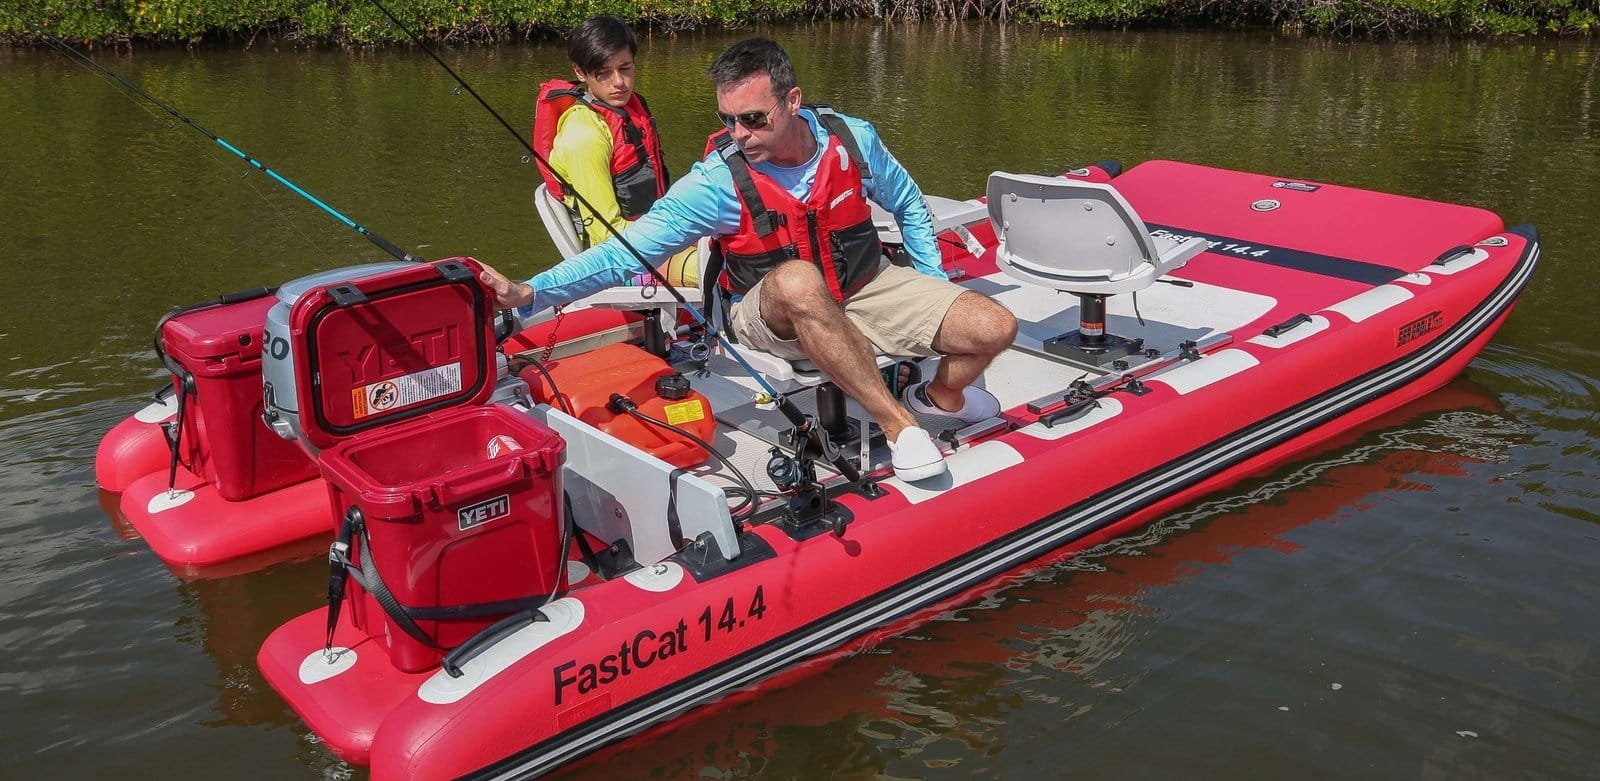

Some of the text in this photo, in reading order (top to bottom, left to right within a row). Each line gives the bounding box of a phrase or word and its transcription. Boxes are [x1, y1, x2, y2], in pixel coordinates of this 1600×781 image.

[1221, 243, 1270, 257] 14.4
[336, 323, 461, 386] YETI
[461, 499, 506, 525] YETI
[553, 584, 766, 706] FastCat 14.4
